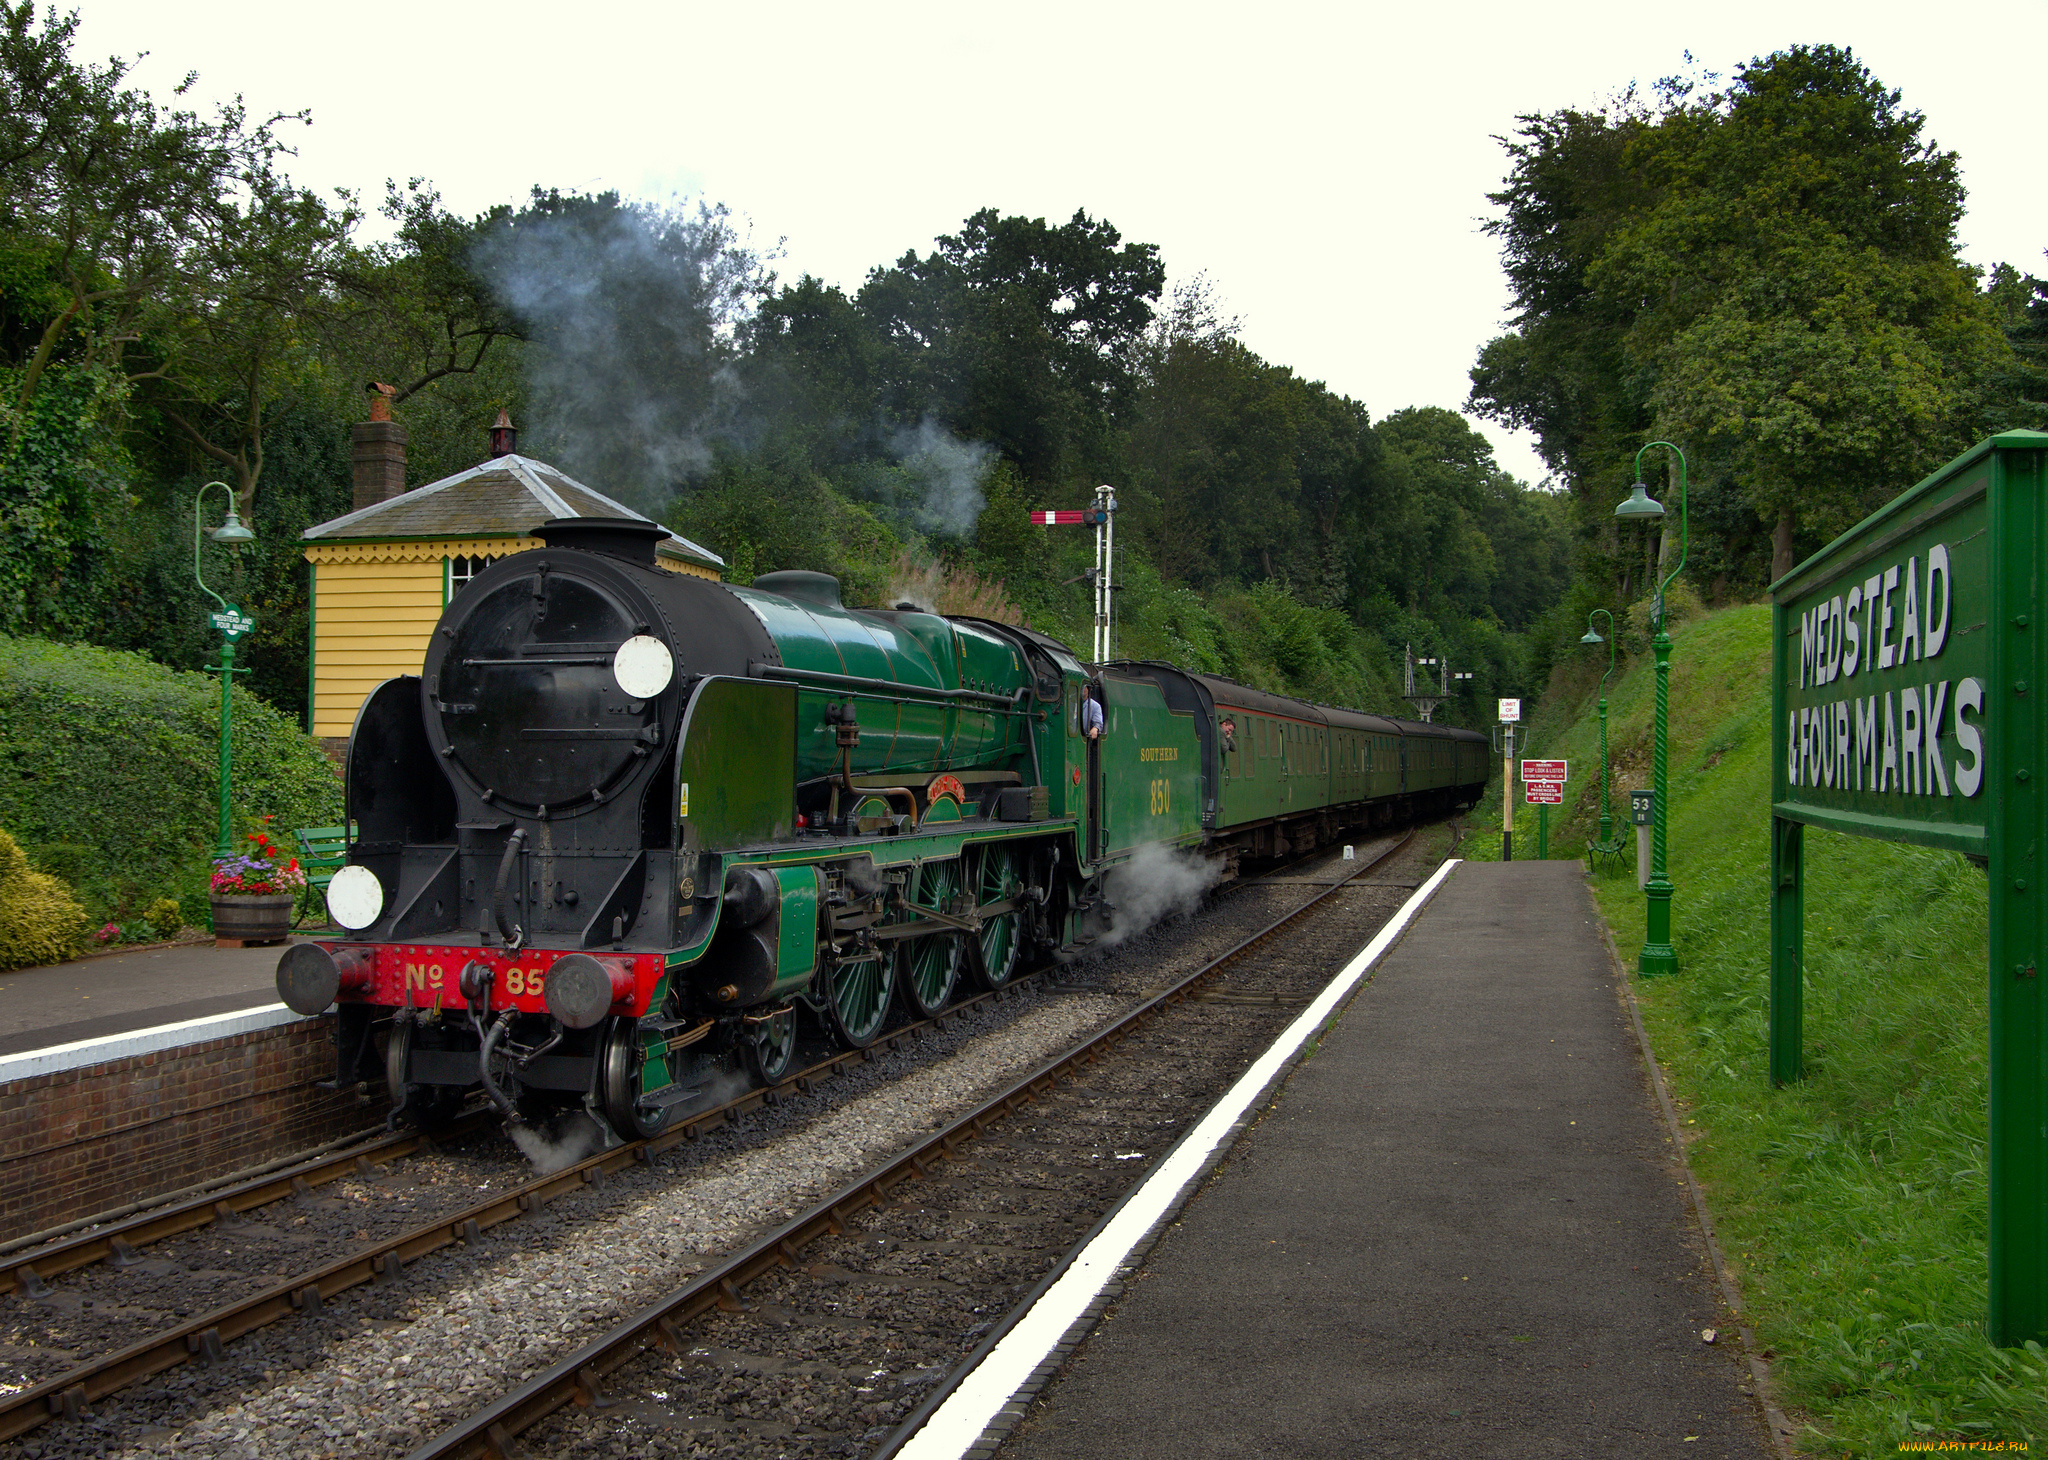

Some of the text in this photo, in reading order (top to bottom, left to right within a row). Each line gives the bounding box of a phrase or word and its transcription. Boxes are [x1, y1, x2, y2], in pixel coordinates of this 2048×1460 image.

[212, 614, 240, 623] MEDSTEAD
[1800, 543, 1950, 690] MEDSTEAD
[216, 621, 249, 631] FOUR MARKS
[1788, 677, 1986, 798] & FOUR MARKS
[1140, 747, 1178, 762] SOUTHERN
[1150, 778, 1170, 816] 850
[1632, 798, 1649, 811] 53
